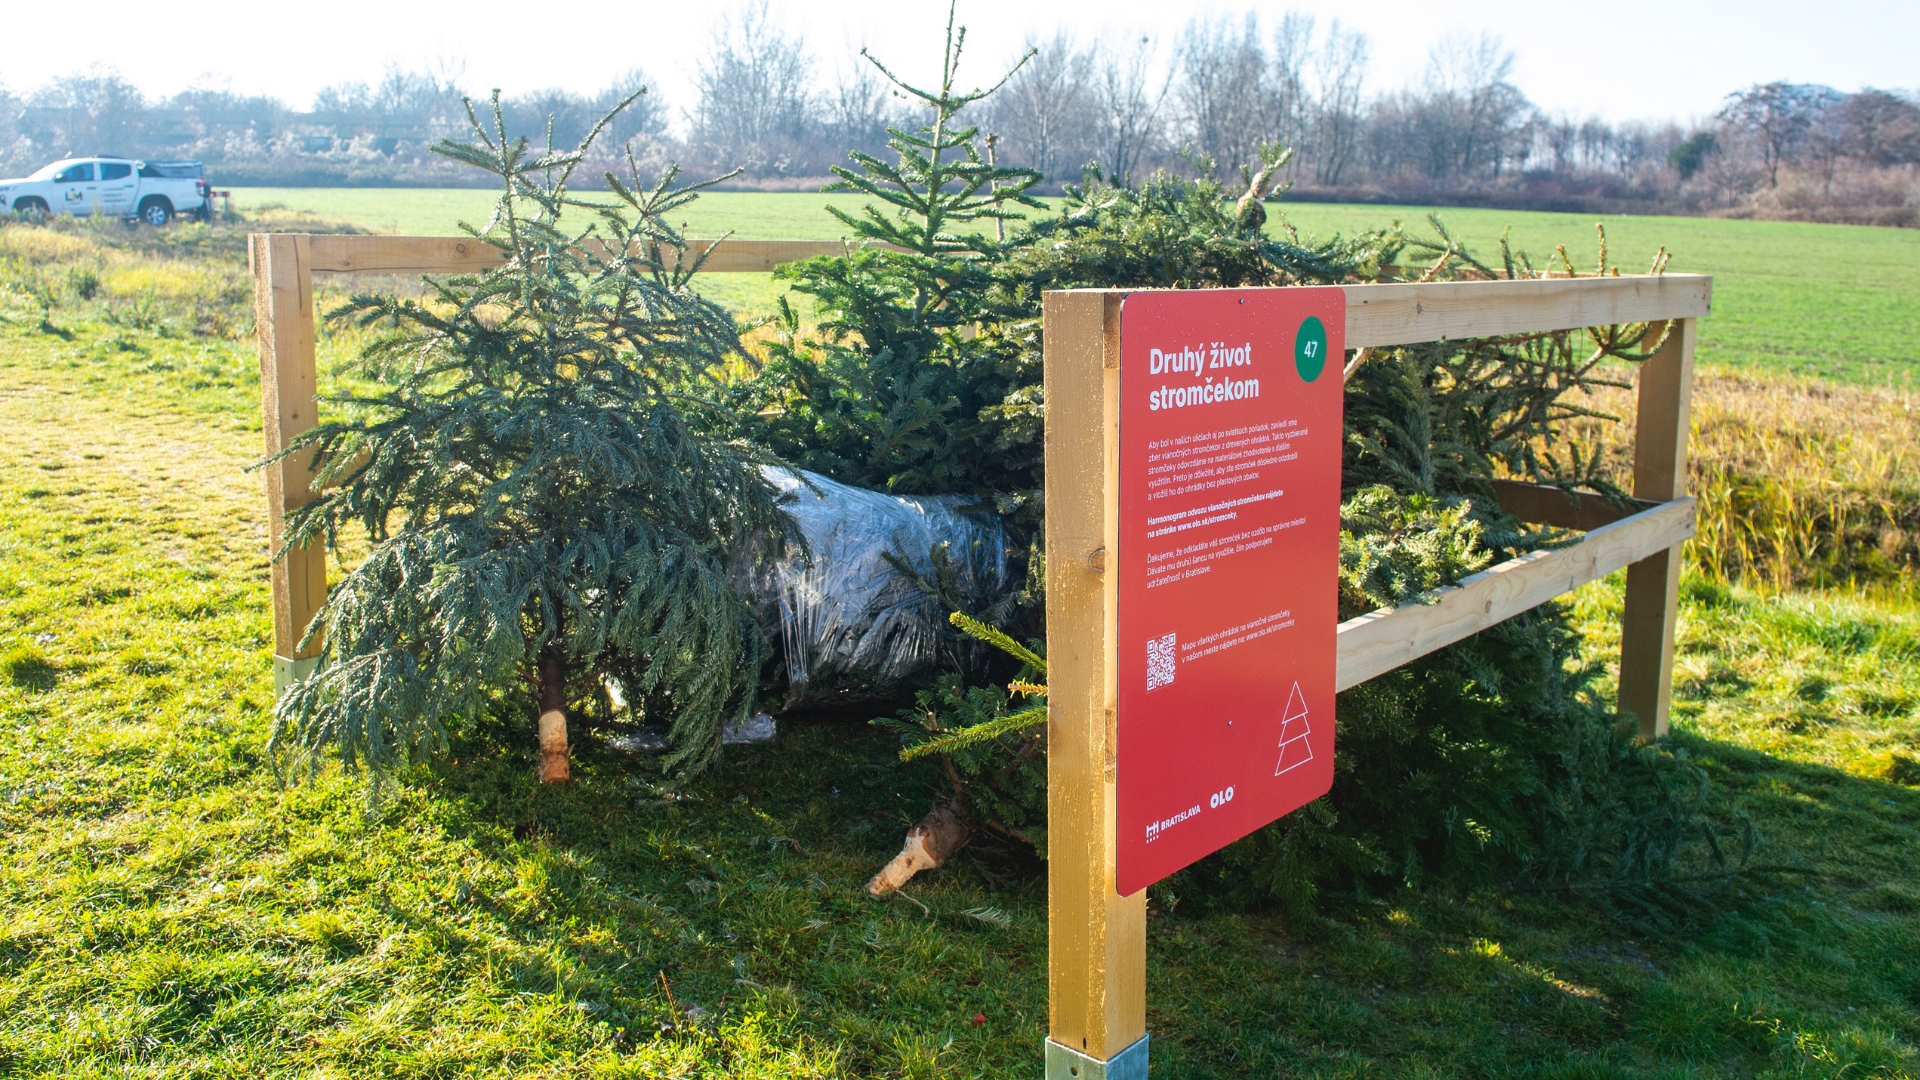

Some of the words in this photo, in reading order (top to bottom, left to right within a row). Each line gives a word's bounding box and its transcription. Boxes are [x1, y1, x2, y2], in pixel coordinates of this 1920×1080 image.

[1150, 343, 1205, 376] Druhý
[1210, 342, 1251, 369] život
[1304, 341, 1318, 358] 47
[1149, 377, 1259, 411] stromčekom
[1148, 440, 1159, 450] Aby
[1160, 438, 1169, 447] bol
[1174, 435, 1191, 444] našich
[1212, 430, 1217, 440] aj
[1218, 431, 1224, 439] po
[1225, 426, 1248, 436] sviatkoch
[1248, 422, 1269, 434] poriadok,
[1148, 453, 1160, 462] zber
[1162, 448, 1191, 459] vianočných
[1192, 444, 1220, 454] stromčekov
[1148, 463, 1176, 475] stromčeky
[1177, 458, 1206, 469] odovzdáme
[1173, 474, 1187, 482] Preto
[1188, 472, 1193, 481] je
[1216, 466, 1225, 475] aby
[1234, 460, 1256, 470] stromček
[1152, 488, 1168, 499] vložili
[1169, 488, 1176, 496] ho
[1176, 486, 1184, 494] do
[1184, 483, 1205, 492] ohrádky
[1206, 480, 1216, 488] bez
[1216, 475, 1242, 488] plastových
[1147, 511, 1187, 525] Harmonogram
[1187, 507, 1207, 516] odvozu
[1207, 499, 1236, 512] vianočných
[1237, 493, 1265, 505] stromčekov
[1265, 489, 1283, 499] nájdete
[1155, 525, 1176, 536] stránke
[1147, 551, 1174, 563] Ďakujeme,
[1176, 548, 1182, 556] že
[1209, 538, 1218, 547] váš
[1218, 533, 1240, 545] stromček
[1241, 531, 1250, 539] bez
[1147, 565, 1166, 576] Dávate
[1176, 557, 1191, 568] druhú
[1192, 554, 1207, 564] šancu
[1236, 544, 1244, 552] čím
[1245, 537, 1272, 551] podporujete
[1185, 565, 1211, 578] Bratislave.
[1181, 641, 1196, 651] Mapu
[1196, 632, 1219, 646] všetkých
[1219, 626, 1239, 638] ohrádok
[1267, 609, 1290, 622] stromčeky
[1186, 650, 1203, 661] našom
[1203, 645, 1219, 655] meste
[1219, 638, 1237, 650] nájdete
[1210, 786, 1234, 809] OLO
[1161, 805, 1201, 831] BRATISLAVA
